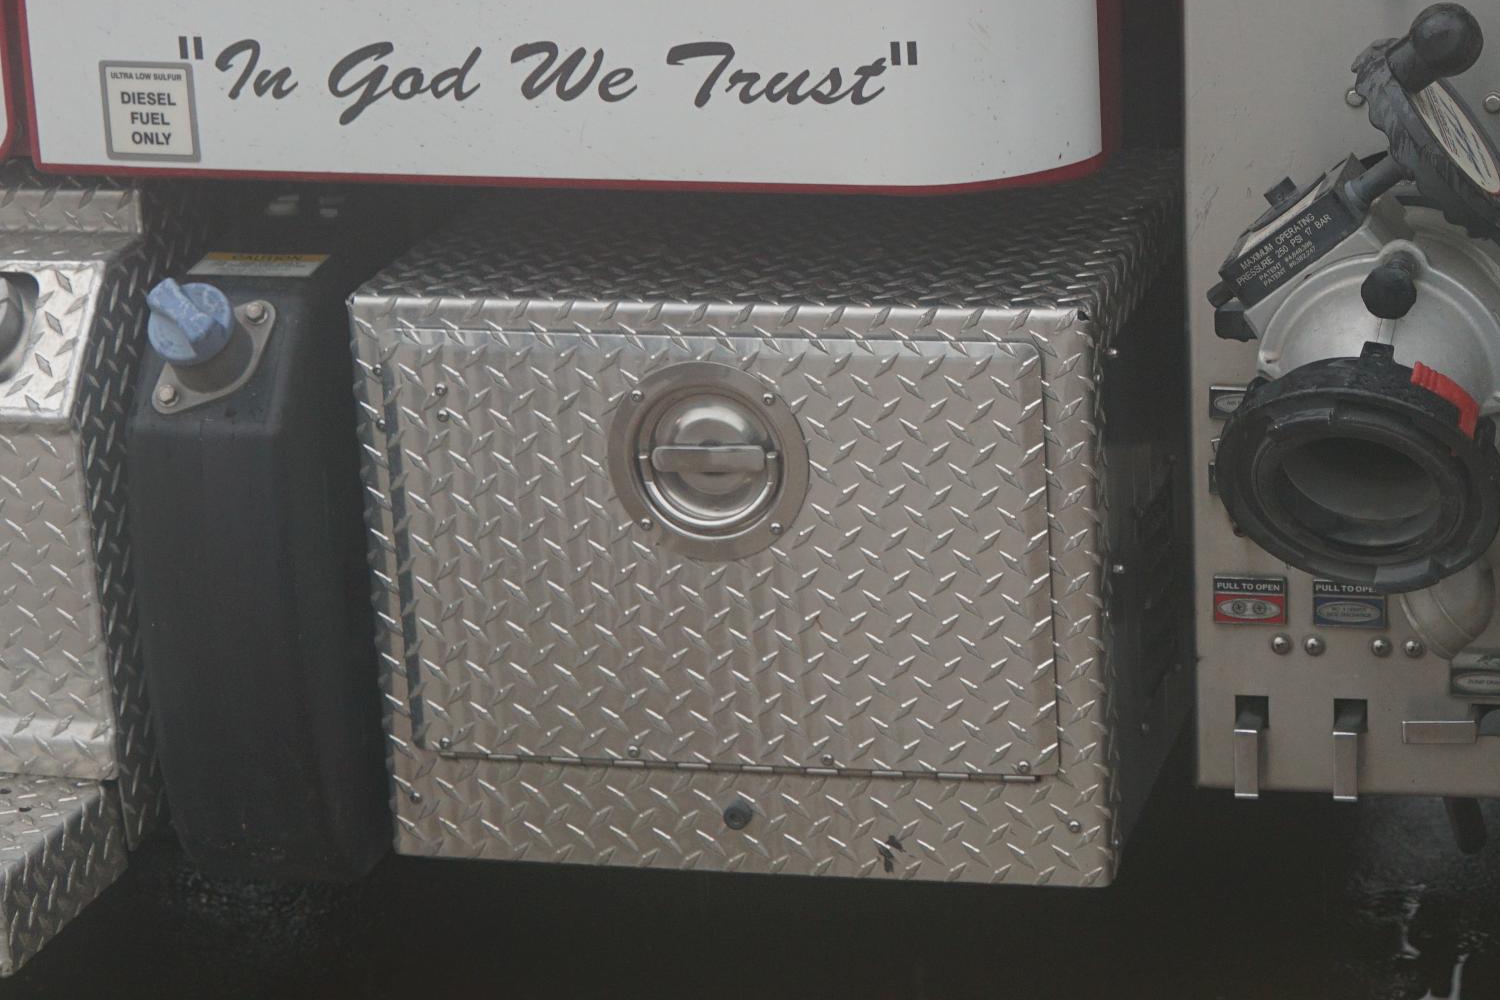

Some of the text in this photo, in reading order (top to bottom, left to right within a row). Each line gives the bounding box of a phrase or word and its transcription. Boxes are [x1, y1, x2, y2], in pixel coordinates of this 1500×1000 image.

[153, 73, 182, 81] SULFUR
[179, 36, 917, 125] "In God We Trust"
[120, 91, 176, 105] DIESEL
[130, 112, 170, 125] FUEL
[132, 132, 171, 145] ONLY
[1240, 213, 1315, 270] MAXIMUM OPERATING
[1236, 214, 1332, 286] PRESSURE 250 PSI 17 BAR
[1259, 262, 1282, 281] PATENT
[1263, 268, 1287, 286] PATENT
[1216, 582, 1239, 590] PULL
[1316, 584, 1340, 592] PULL
